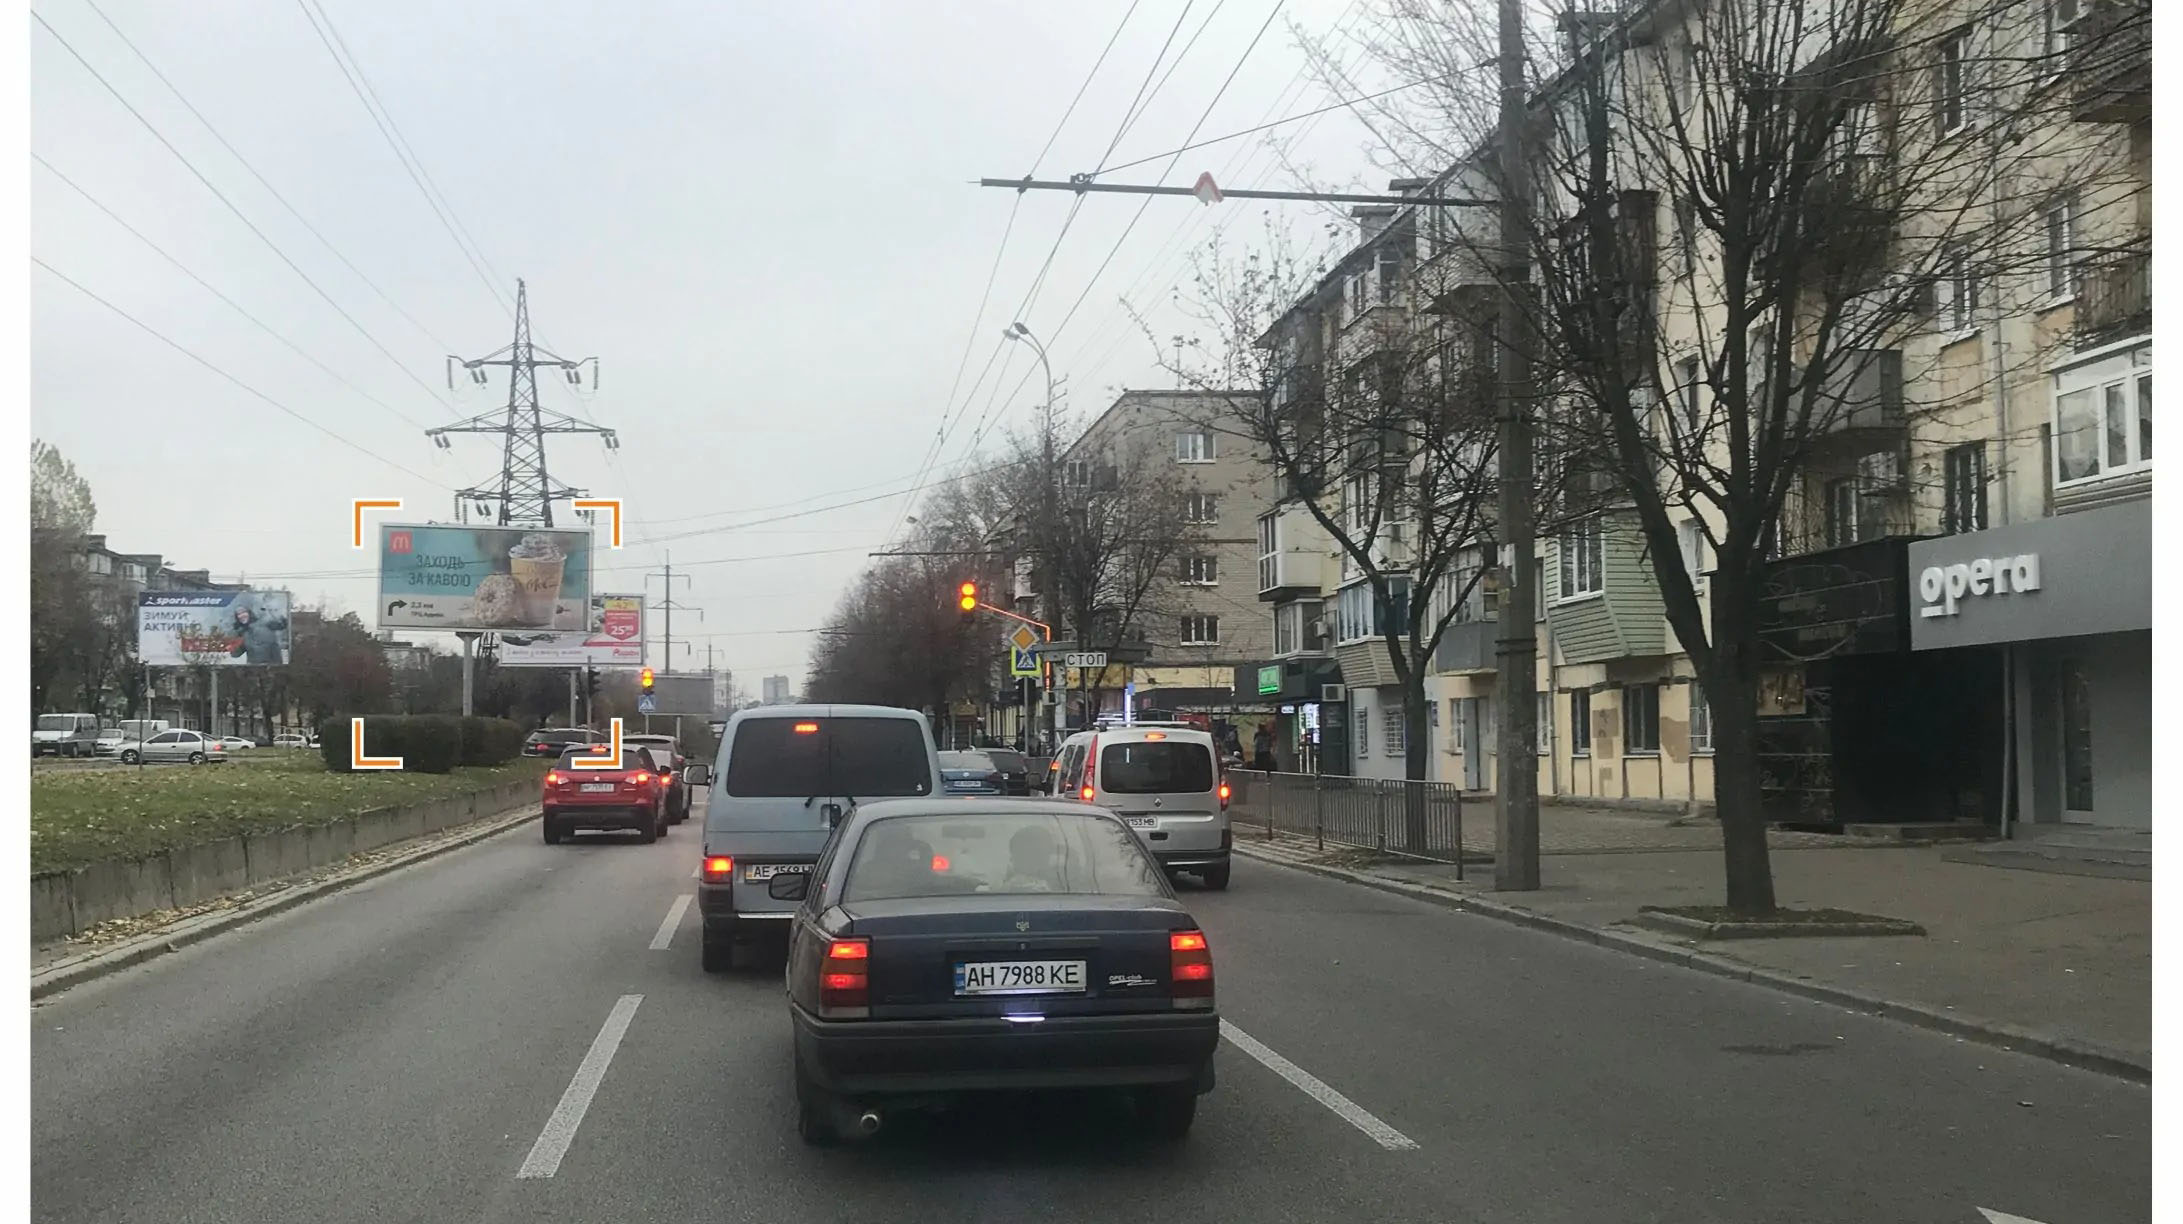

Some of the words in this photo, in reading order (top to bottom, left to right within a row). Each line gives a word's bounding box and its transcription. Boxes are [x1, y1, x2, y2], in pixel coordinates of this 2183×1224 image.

[416, 554, 465, 570] ЗАХОДЬ
[408, 572, 424, 586] ЗА
[427, 573, 471, 587] КАВОЮ
[1919, 553, 2041, 617] opera
[143, 622, 202, 632] АКТИВНО
[1067, 654, 1104, 666] СТОП
[753, 866, 771, 878] AE
[967, 966, 995, 987] AH
[1000, 965, 1045, 986] 7988
[1050, 964, 1079, 984] KE
